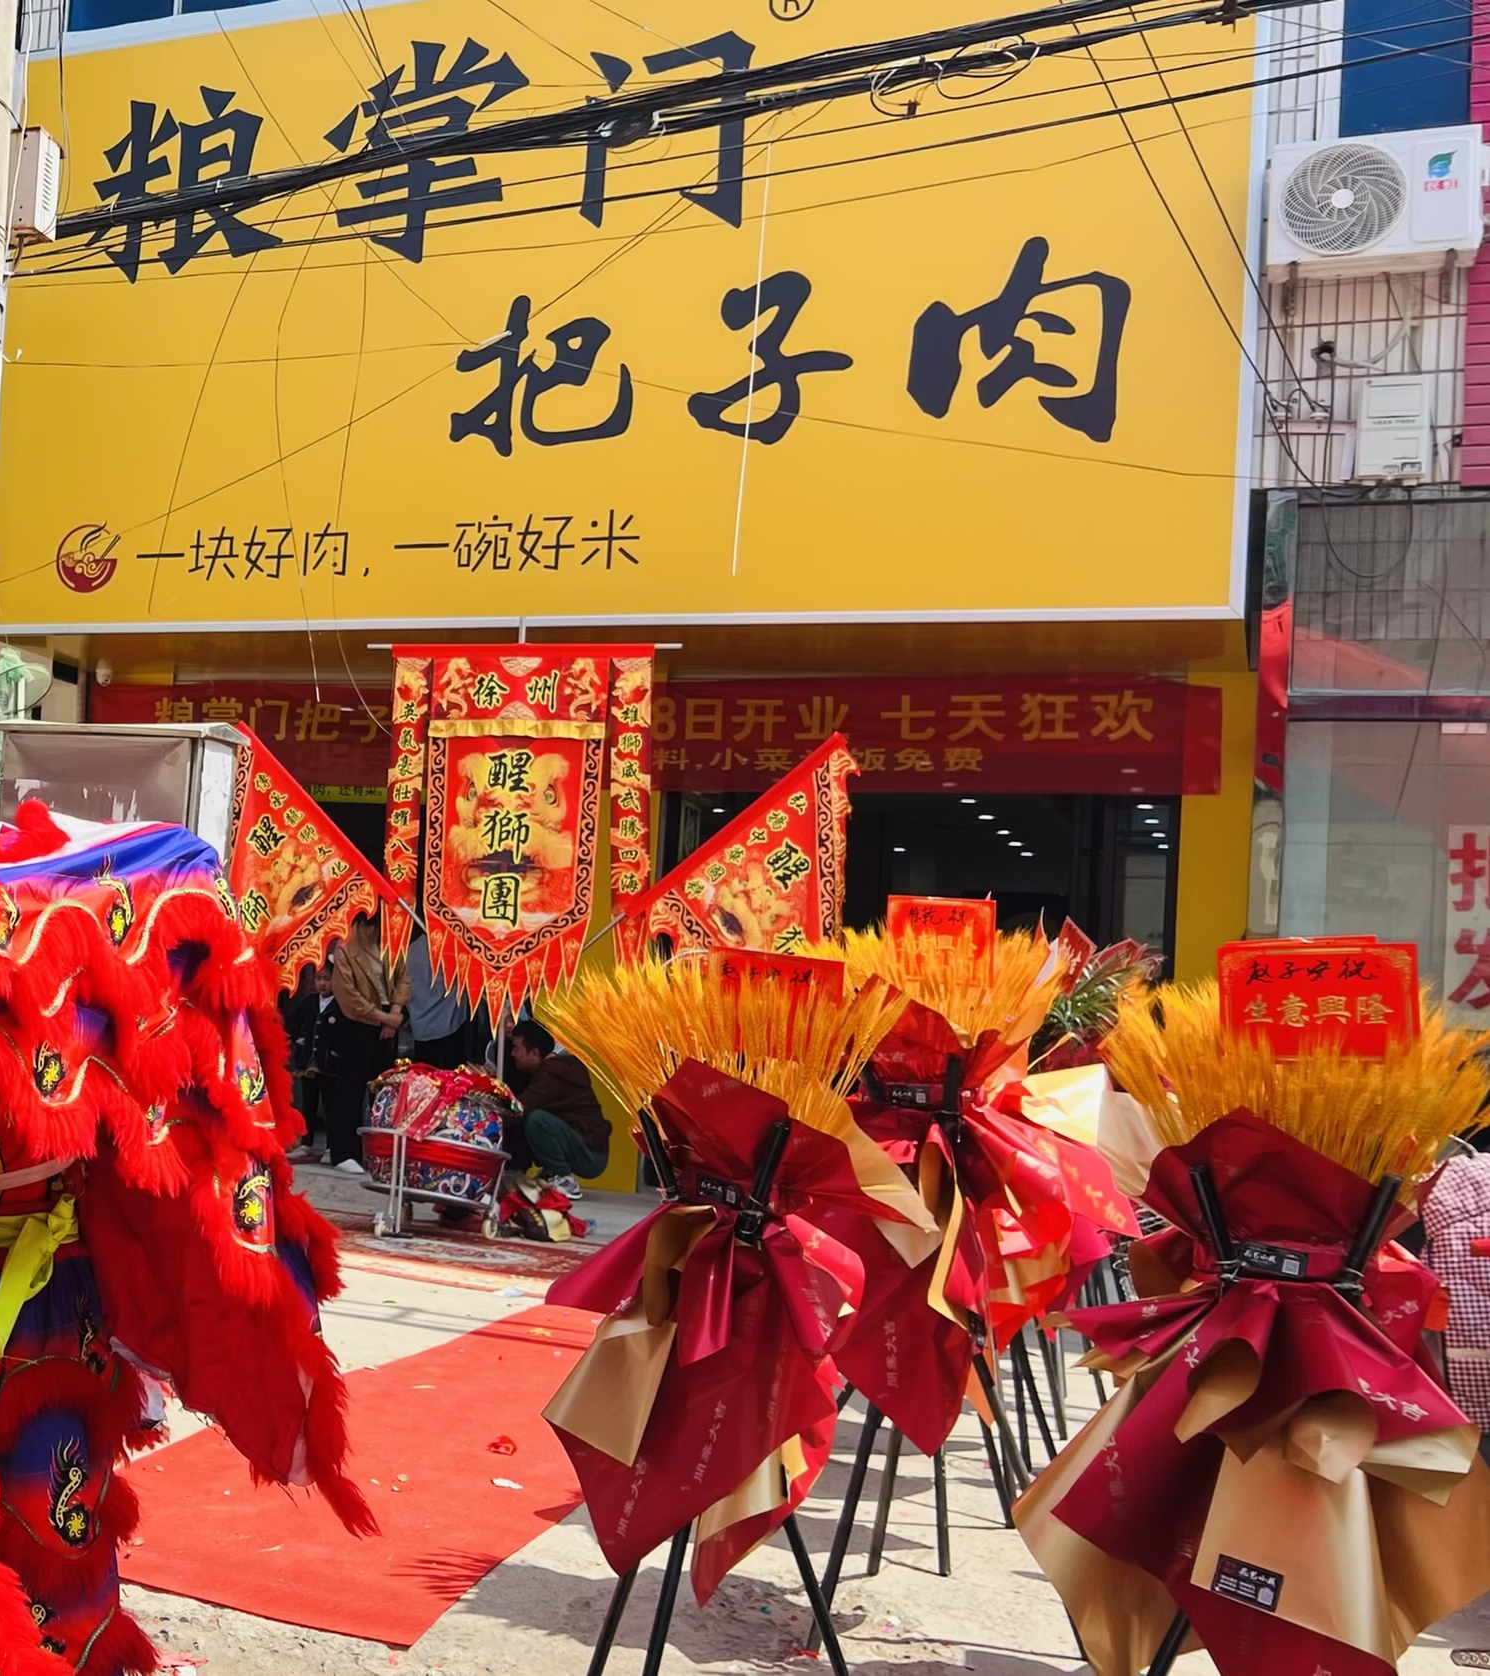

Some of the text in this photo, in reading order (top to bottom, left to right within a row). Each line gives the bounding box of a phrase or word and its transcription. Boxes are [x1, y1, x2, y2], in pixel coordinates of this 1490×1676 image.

[85, 30, 755, 284] 粮掌门
[449, 237, 1131, 456] 把子肉
[136, 508, 640, 581] 一块好肉，一碗好米
[472, 671, 558, 712] 徐州
[880, 689, 1156, 742] 七天狂欢
[481, 751, 533, 928] 醒獅團
[1243, 991, 1394, 1028] 生意興隆
